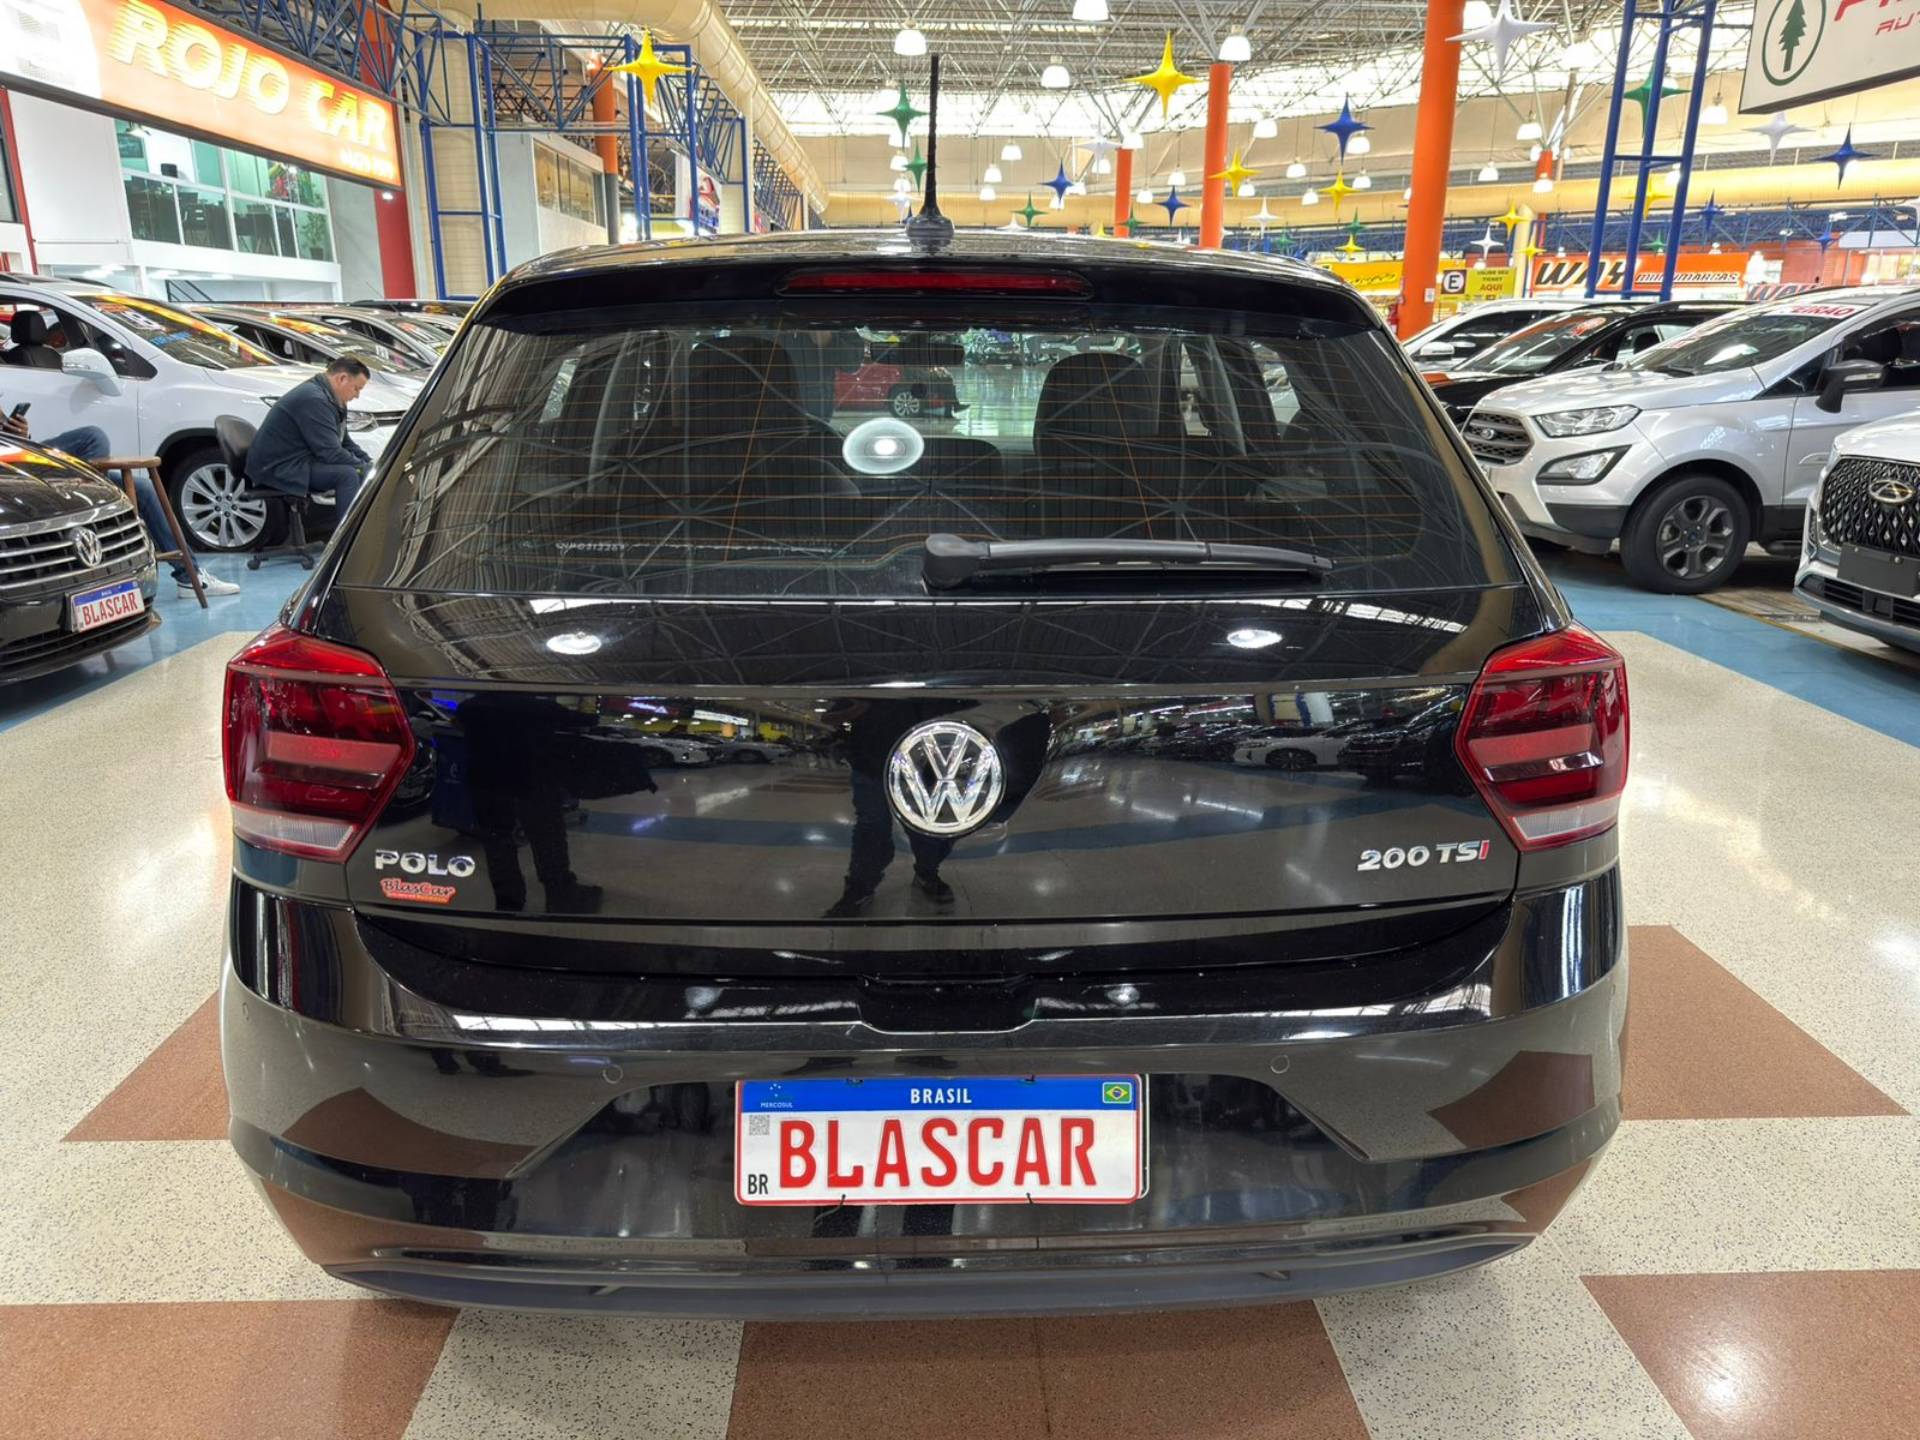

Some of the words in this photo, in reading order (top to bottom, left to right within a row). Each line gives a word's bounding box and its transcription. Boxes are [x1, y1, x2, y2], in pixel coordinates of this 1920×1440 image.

[1875, 12, 1920, 36] AU
[108, 0, 290, 115] ROJO
[302, 78, 389, 152] CAR
[1448, 274, 1460, 290] E
[1479, 283, 1503, 292] AQUI
[82, 592, 138, 625] BLASCAR
[374, 849, 476, 878] POLO
[1357, 846, 1430, 871] 200
[1436, 840, 1490, 863] TSI
[910, 1088, 972, 1104] BRASIL
[780, 1118, 1096, 1188] BLASCAR
[748, 1174, 768, 1194] BR
